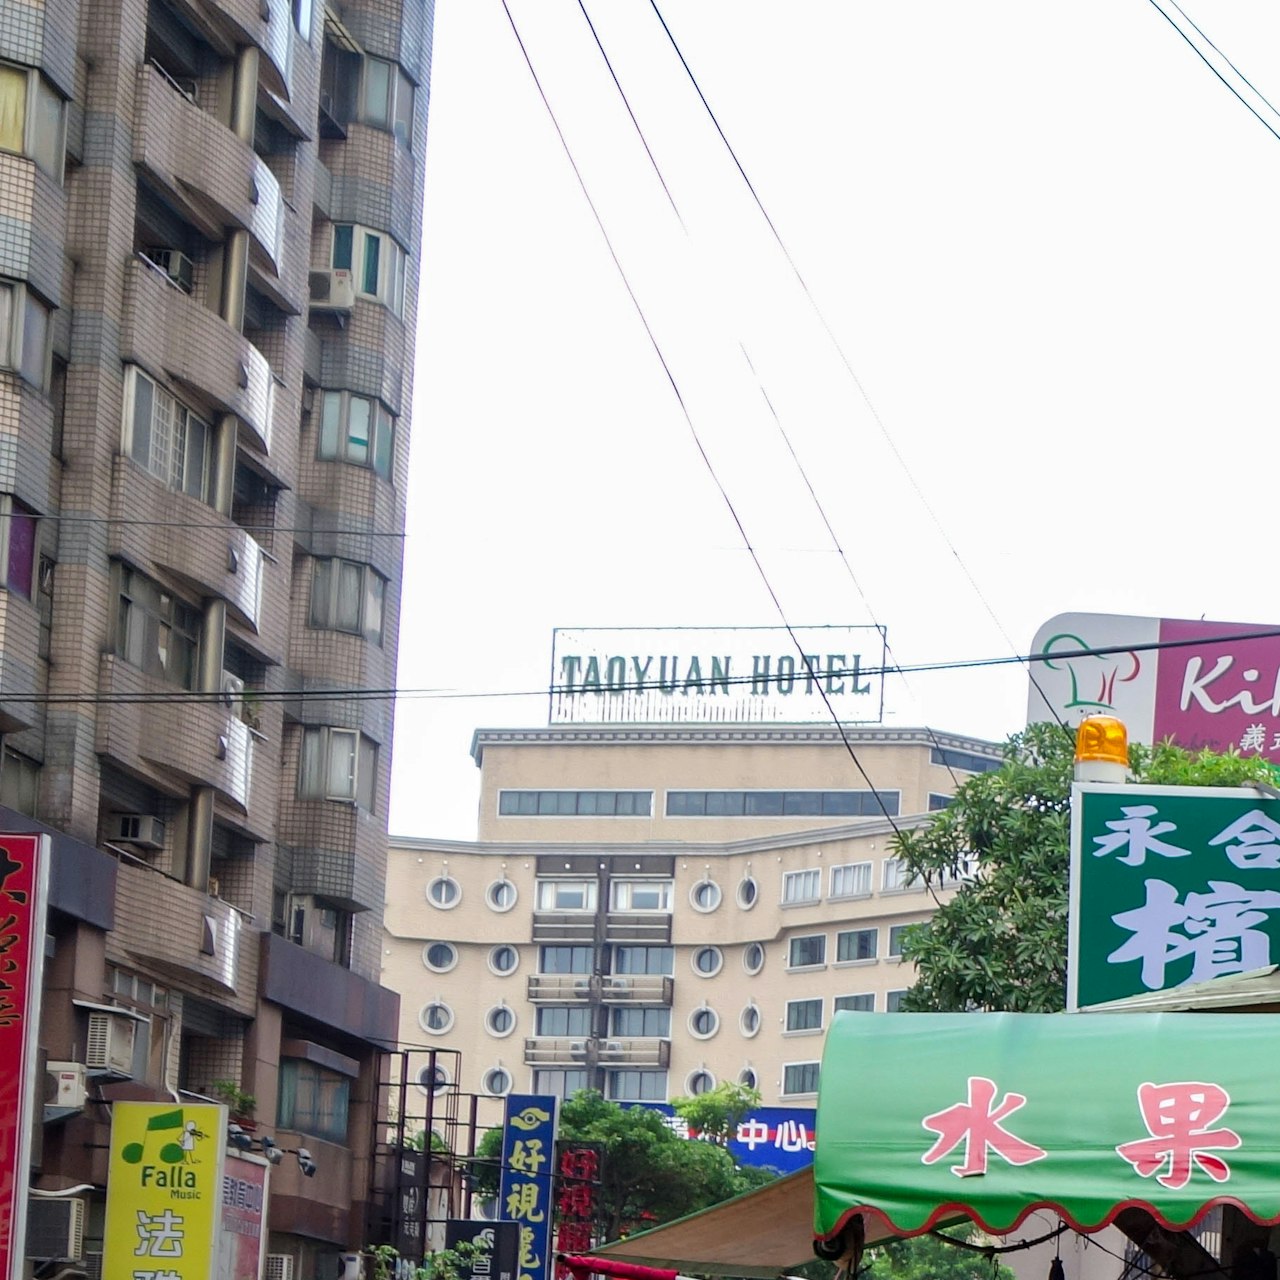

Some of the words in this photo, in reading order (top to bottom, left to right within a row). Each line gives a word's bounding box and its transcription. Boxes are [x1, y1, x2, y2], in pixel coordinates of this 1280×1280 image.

[561, 655, 732, 697] TAOYUAN
[750, 653, 871, 696] HOTEL
[922, 1076, 1243, 1190] 水果
[141, 1165, 197, 1188] Falla
[170, 1189, 201, 1200] Music
